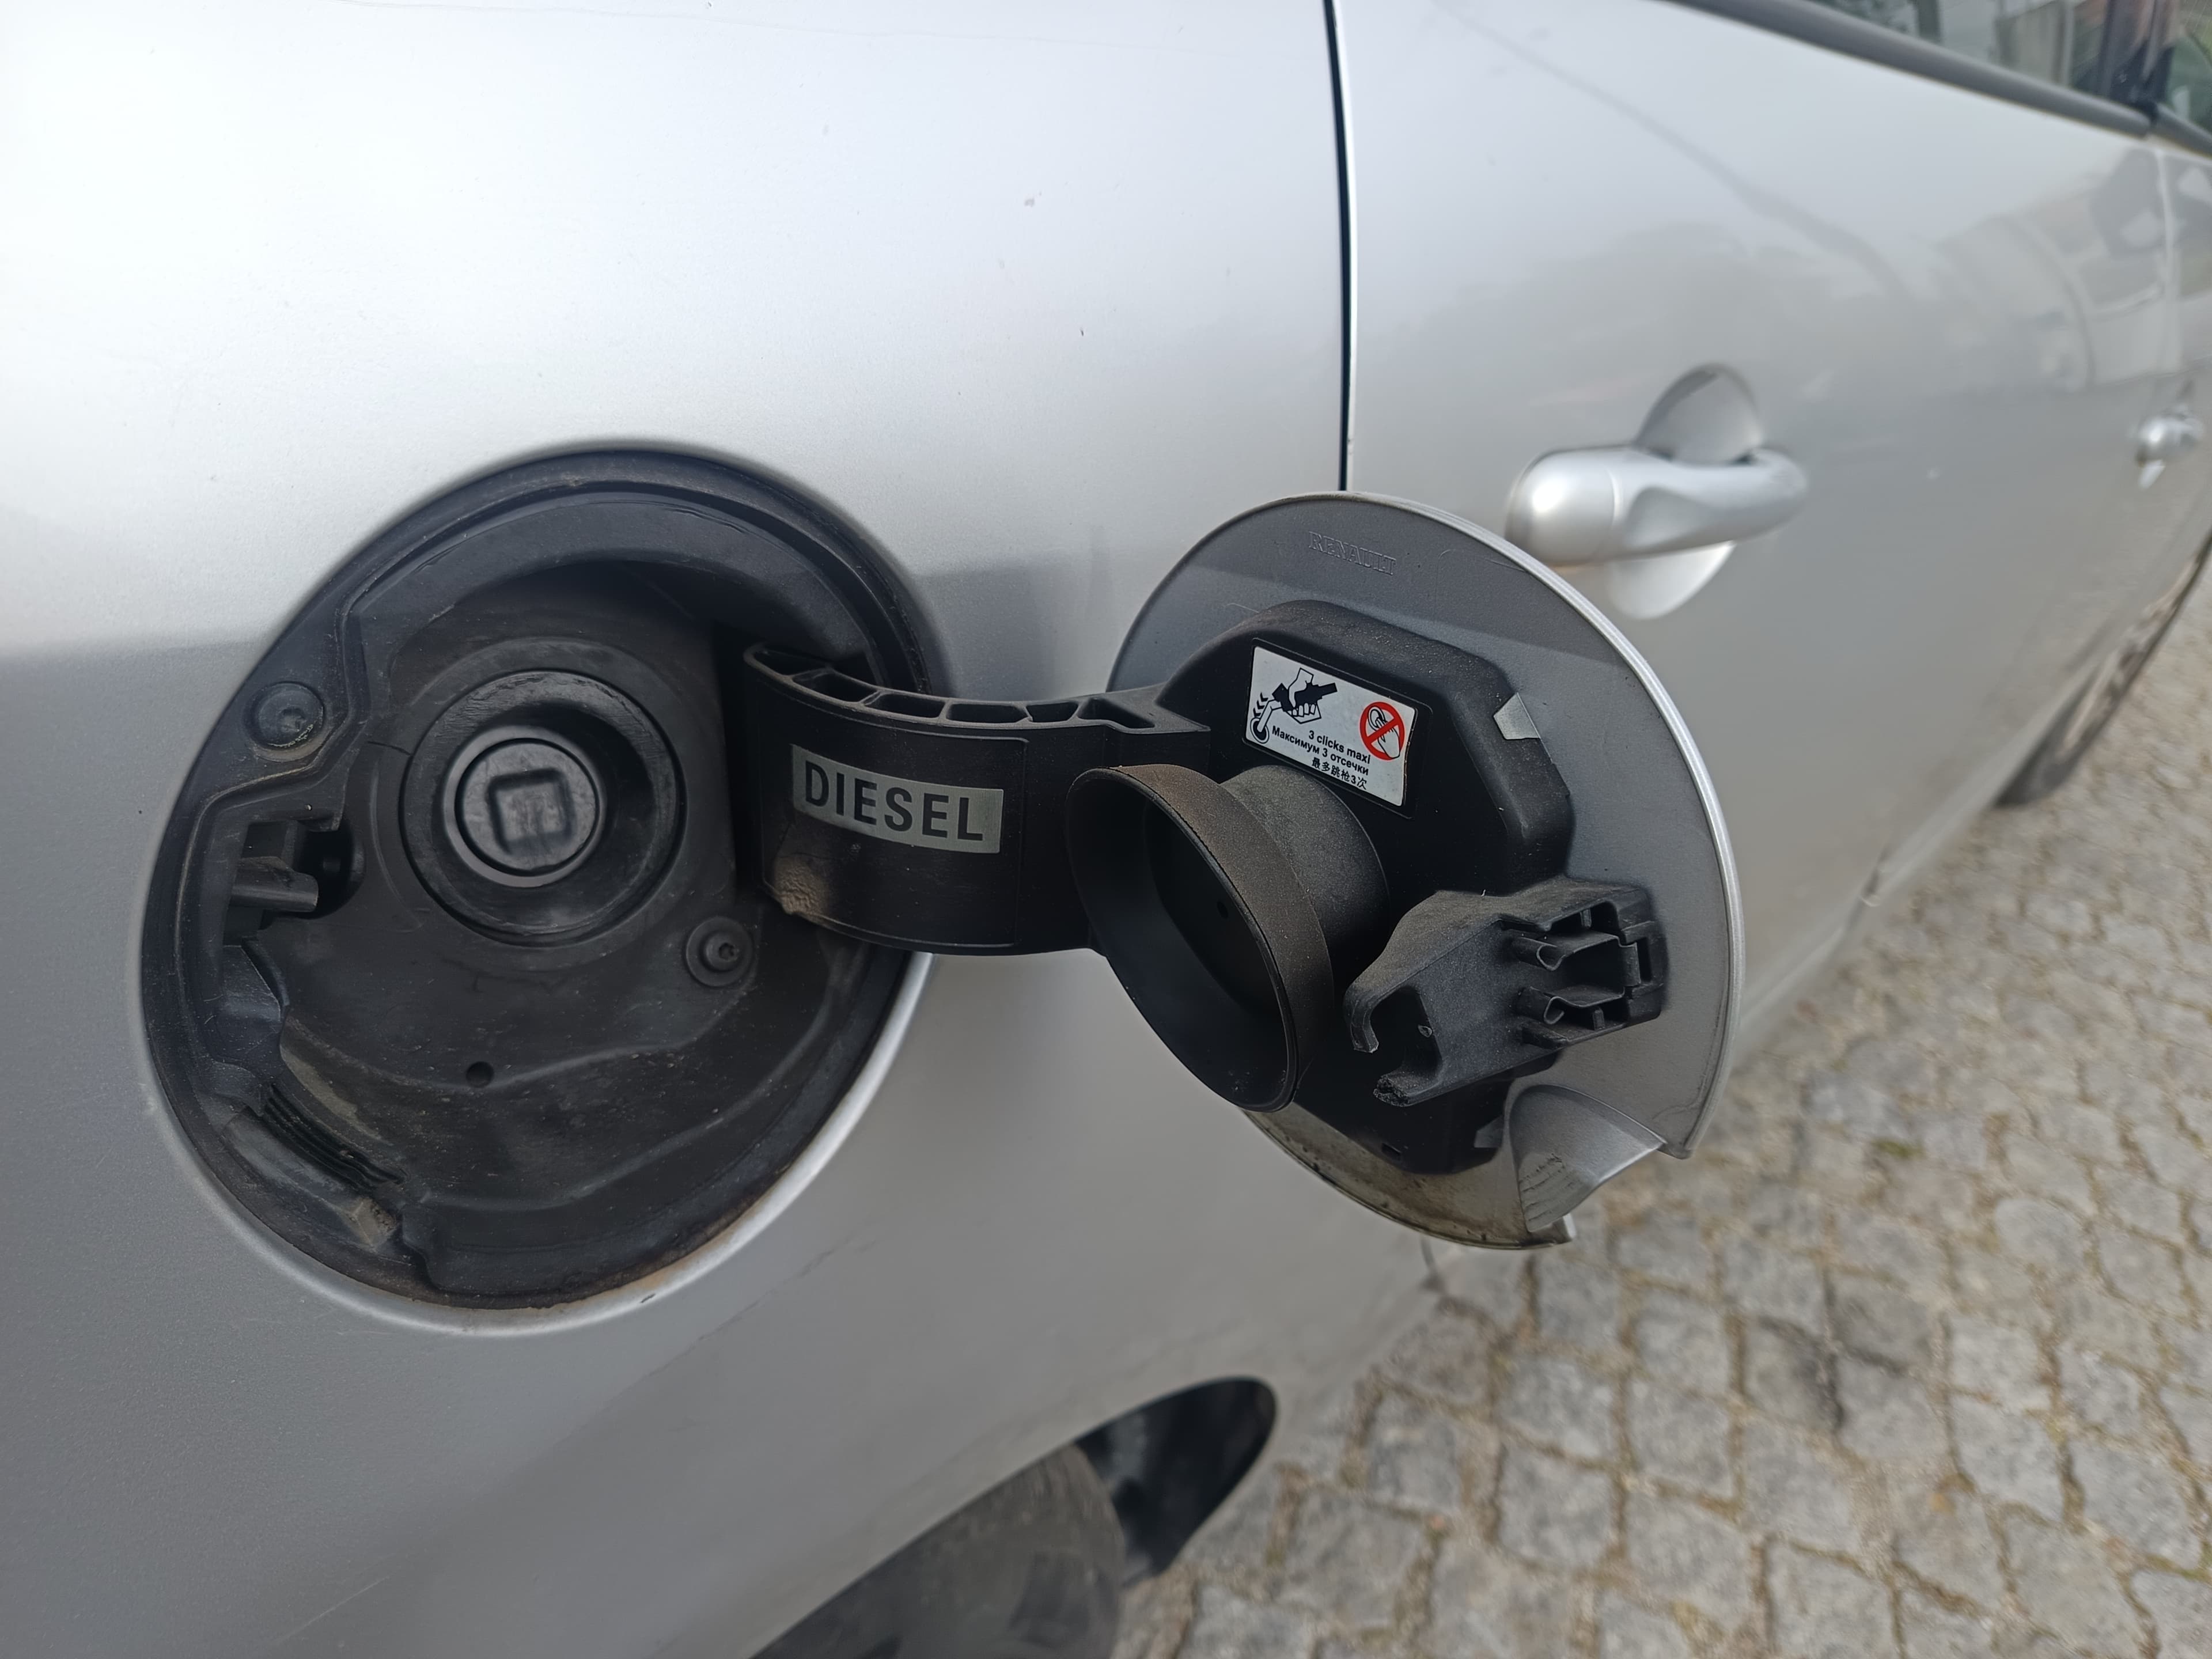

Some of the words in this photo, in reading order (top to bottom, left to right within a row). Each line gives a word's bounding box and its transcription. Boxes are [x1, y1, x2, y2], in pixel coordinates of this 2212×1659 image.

[1272, 726, 1319, 755] Максимум
[1322, 748, 1328, 757] 3
[1331, 753, 1369, 775] отсечки
[1308, 730, 1315, 740] 3
[1317, 734, 1344, 753] clicks
[1347, 748, 1370, 764] maxi
[1312, 757, 1367, 790] 最多跳枪3次
[805, 760, 983, 841] DIESEL
